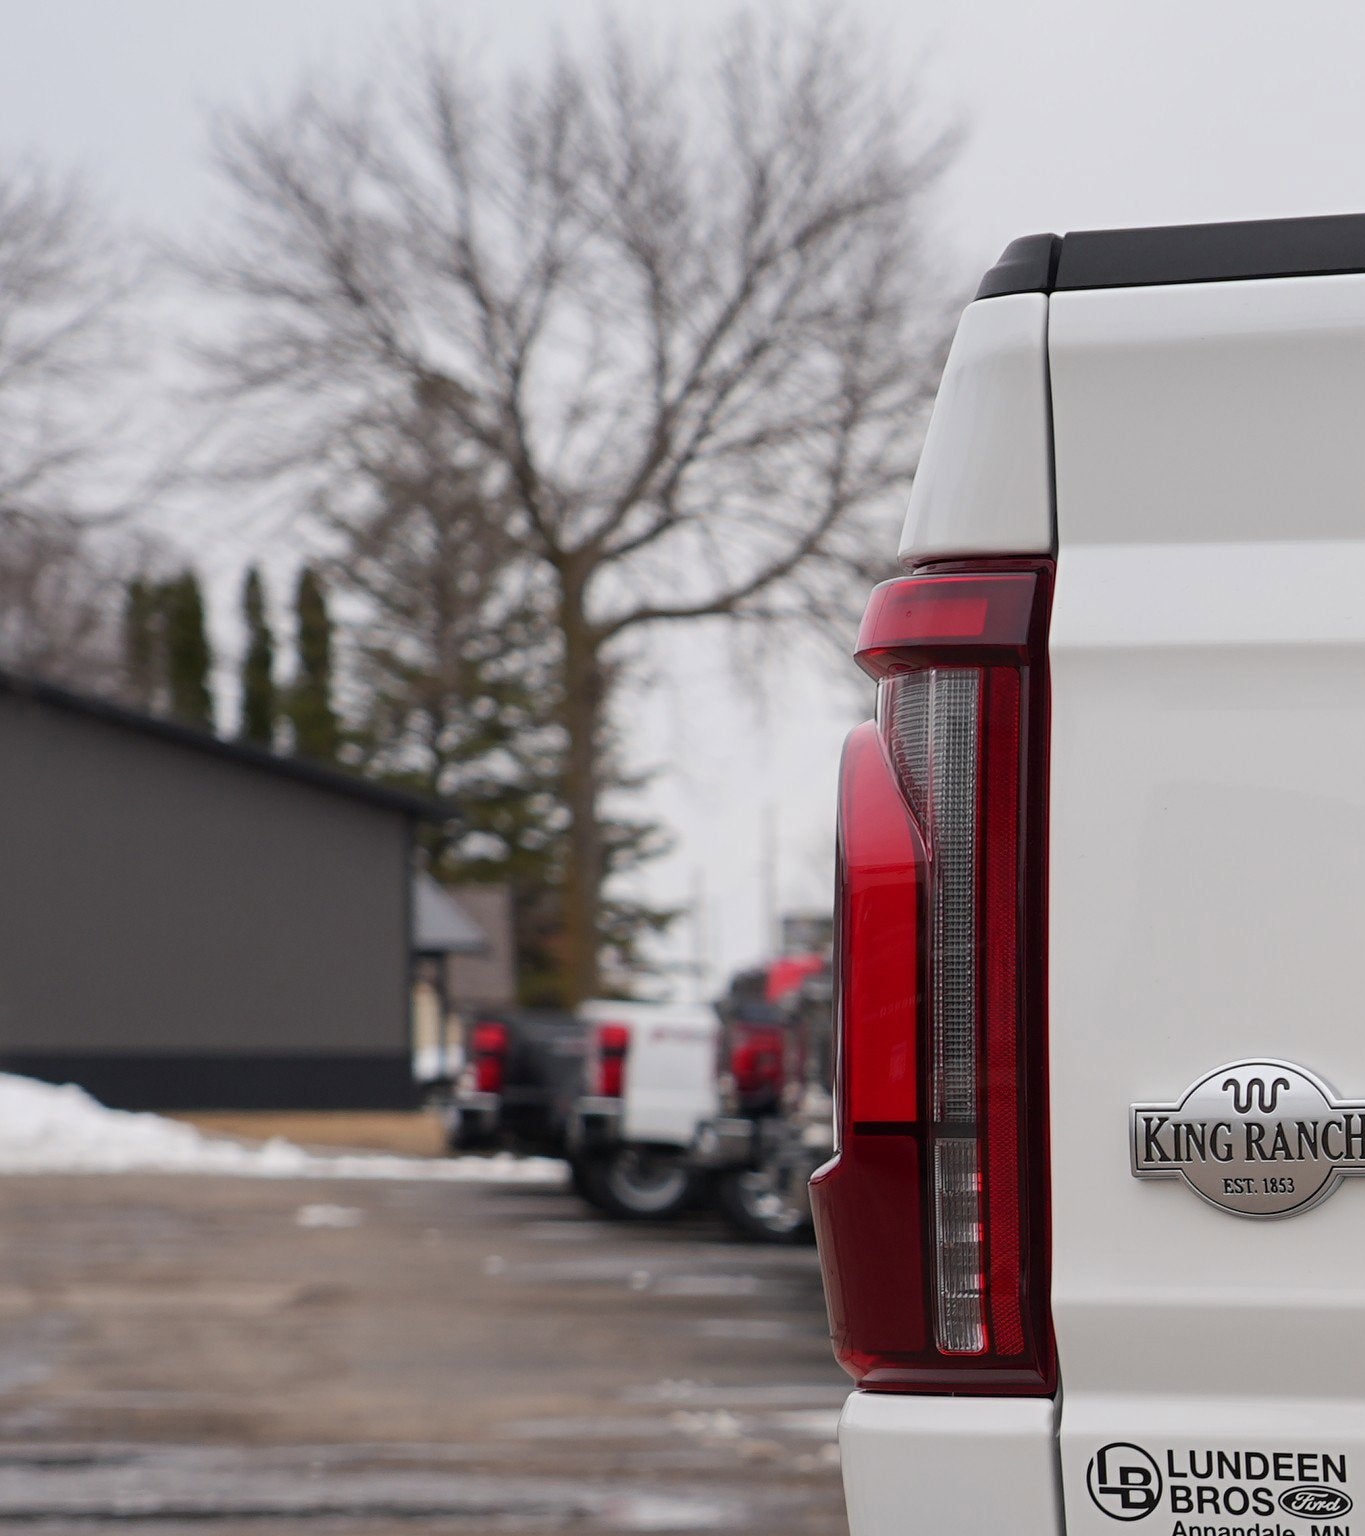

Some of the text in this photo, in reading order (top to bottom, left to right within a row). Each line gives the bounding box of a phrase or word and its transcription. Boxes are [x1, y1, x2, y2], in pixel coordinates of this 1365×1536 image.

[1142, 1116, 1235, 1163] KING
[1222, 1178, 1296, 1195] EST. 1853
[1166, 1449, 1347, 1483] LUNDEEN
[1170, 1485, 1342, 1517] BROS Ford
